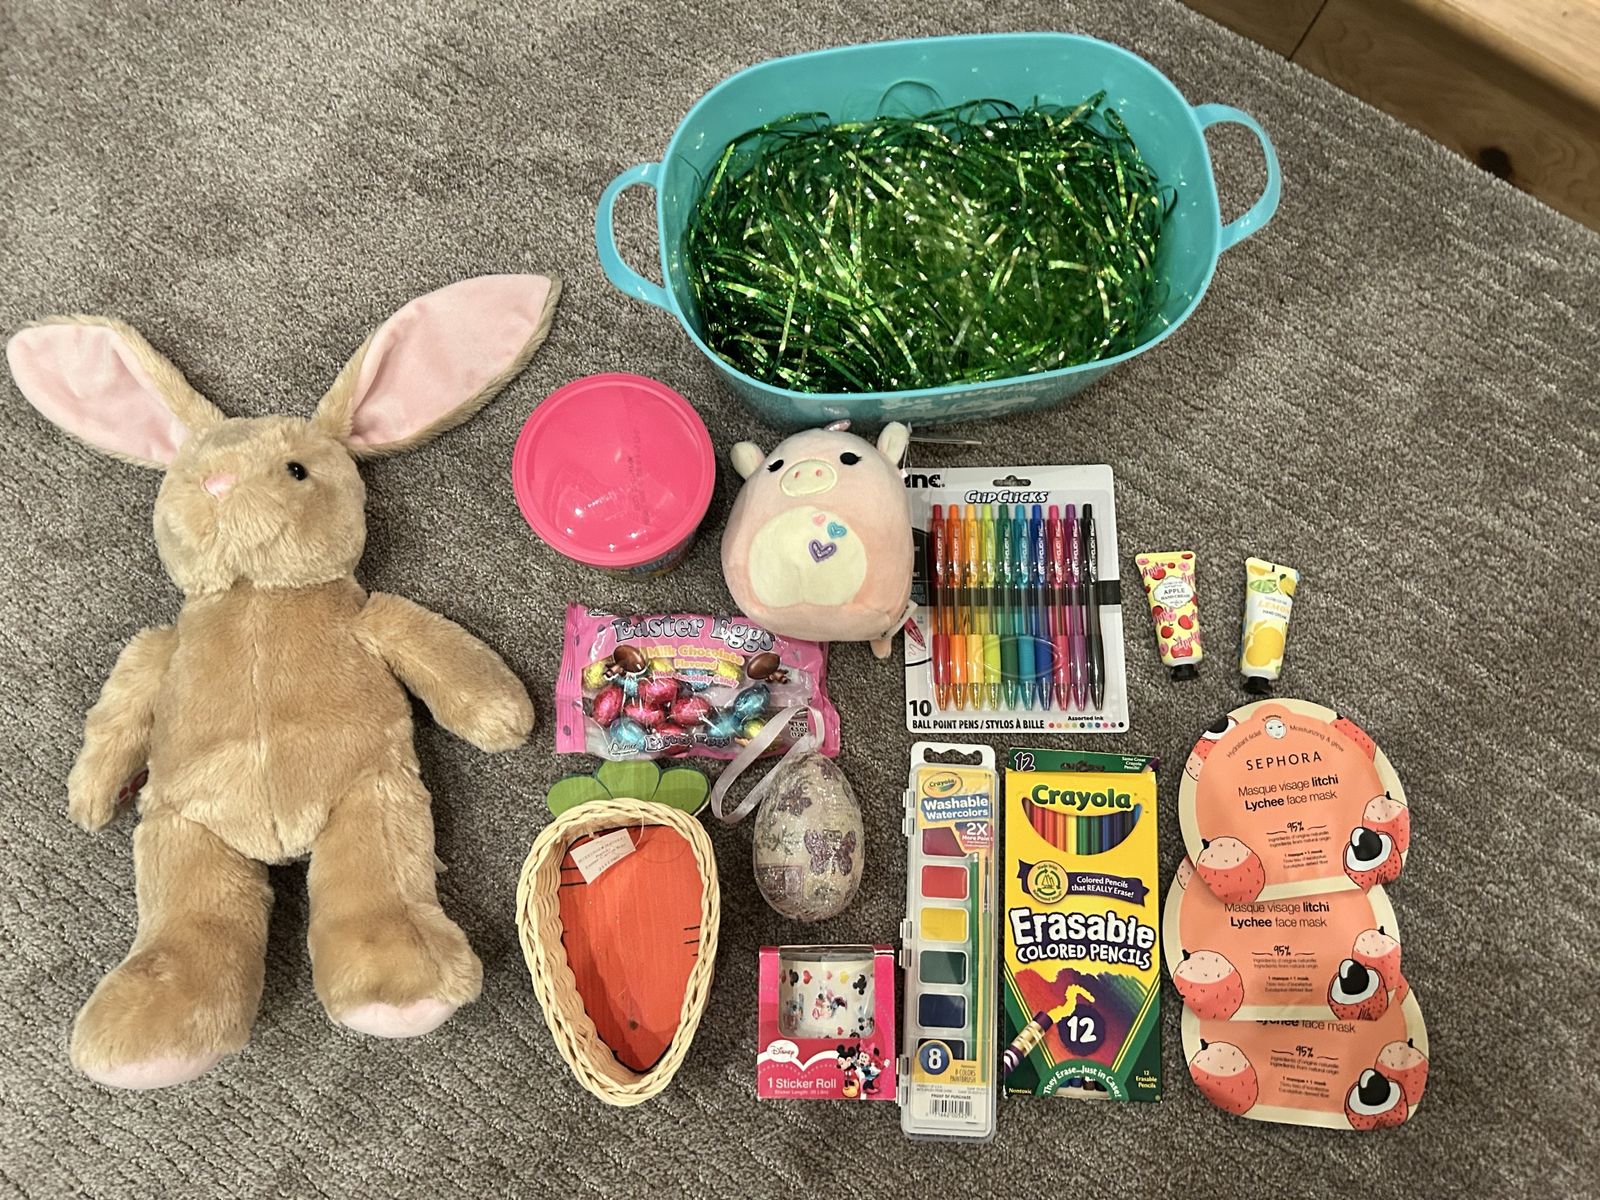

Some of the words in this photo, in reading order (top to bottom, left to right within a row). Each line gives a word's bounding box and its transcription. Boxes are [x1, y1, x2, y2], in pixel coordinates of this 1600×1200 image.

[1163, 587, 1186, 595] APPLE
[611, 616, 704, 642] Easter
[711, 616, 776, 652] Eggs
[647, 645, 677, 658] Milk
[678, 646, 745, 666] Chocolate
[674, 659, 717, 669] Flavored
[712, 677, 739, 688] Candy
[909, 700, 932, 716] 10
[912, 720, 931, 729] BALL
[933, 720, 957, 729] POINT
[959, 720, 979, 729] PENS
[986, 719, 1014, 729] STYLOS
[1016, 718, 1022, 729] À
[1023, 719, 1044, 729] BILLE
[1014, 752, 1035, 771] 12
[1246, 751, 1322, 771] SEPHORA
[929, 779, 956, 787] Crayola
[1238, 785, 1277, 797] Masque
[1279, 780, 1310, 791] visage
[1311, 774, 1339, 787] litchi
[924, 796, 989, 810] Washable
[1031, 784, 1132, 811] Crayola
[1244, 798, 1284, 811] Lychee
[1286, 794, 1307, 805] face
[1309, 790, 1337, 802] mask
[926, 808, 989, 820] Watercolors
[967, 823, 988, 836] 2X
[1287, 821, 1304, 832] 95%
[1077, 876, 1104, 884] Colored
[1105, 877, 1128, 888] Pencils
[1087, 885, 1113, 893] REALLY
[1113, 887, 1134, 898] Erase!
[1224, 903, 1265, 914] Masque
[1267, 902, 1300, 914] visage
[1303, 901, 1330, 912] litchi
[1009, 908, 1156, 949] Erasable
[1230, 916, 1272, 929] Lychee
[1275, 916, 1297, 927] face
[1300, 917, 1327, 927] mask
[1017, 944, 1087, 963] COLORED
[1090, 944, 1151, 969] PENCILS
[1274, 945, 1291, 956] 95%
[1067, 1015, 1097, 1043] 12
[1256, 1019, 1299, 1027] ycee
[1301, 1020, 1325, 1030] face
[1327, 1023, 1356, 1033] mask
[770, 1046, 795, 1057] Disney
[1295, 1045, 1314, 1058] 95%
[928, 1048, 942, 1070] 8
[768, 1077, 773, 1088] 1
[776, 1078, 814, 1089] Sticker
[816, 1078, 837, 1089] Roll
[1043, 1076, 1057, 1095] They
[1097, 1069, 1107, 1080] in
[1106, 1076, 1122, 1098] Case!
